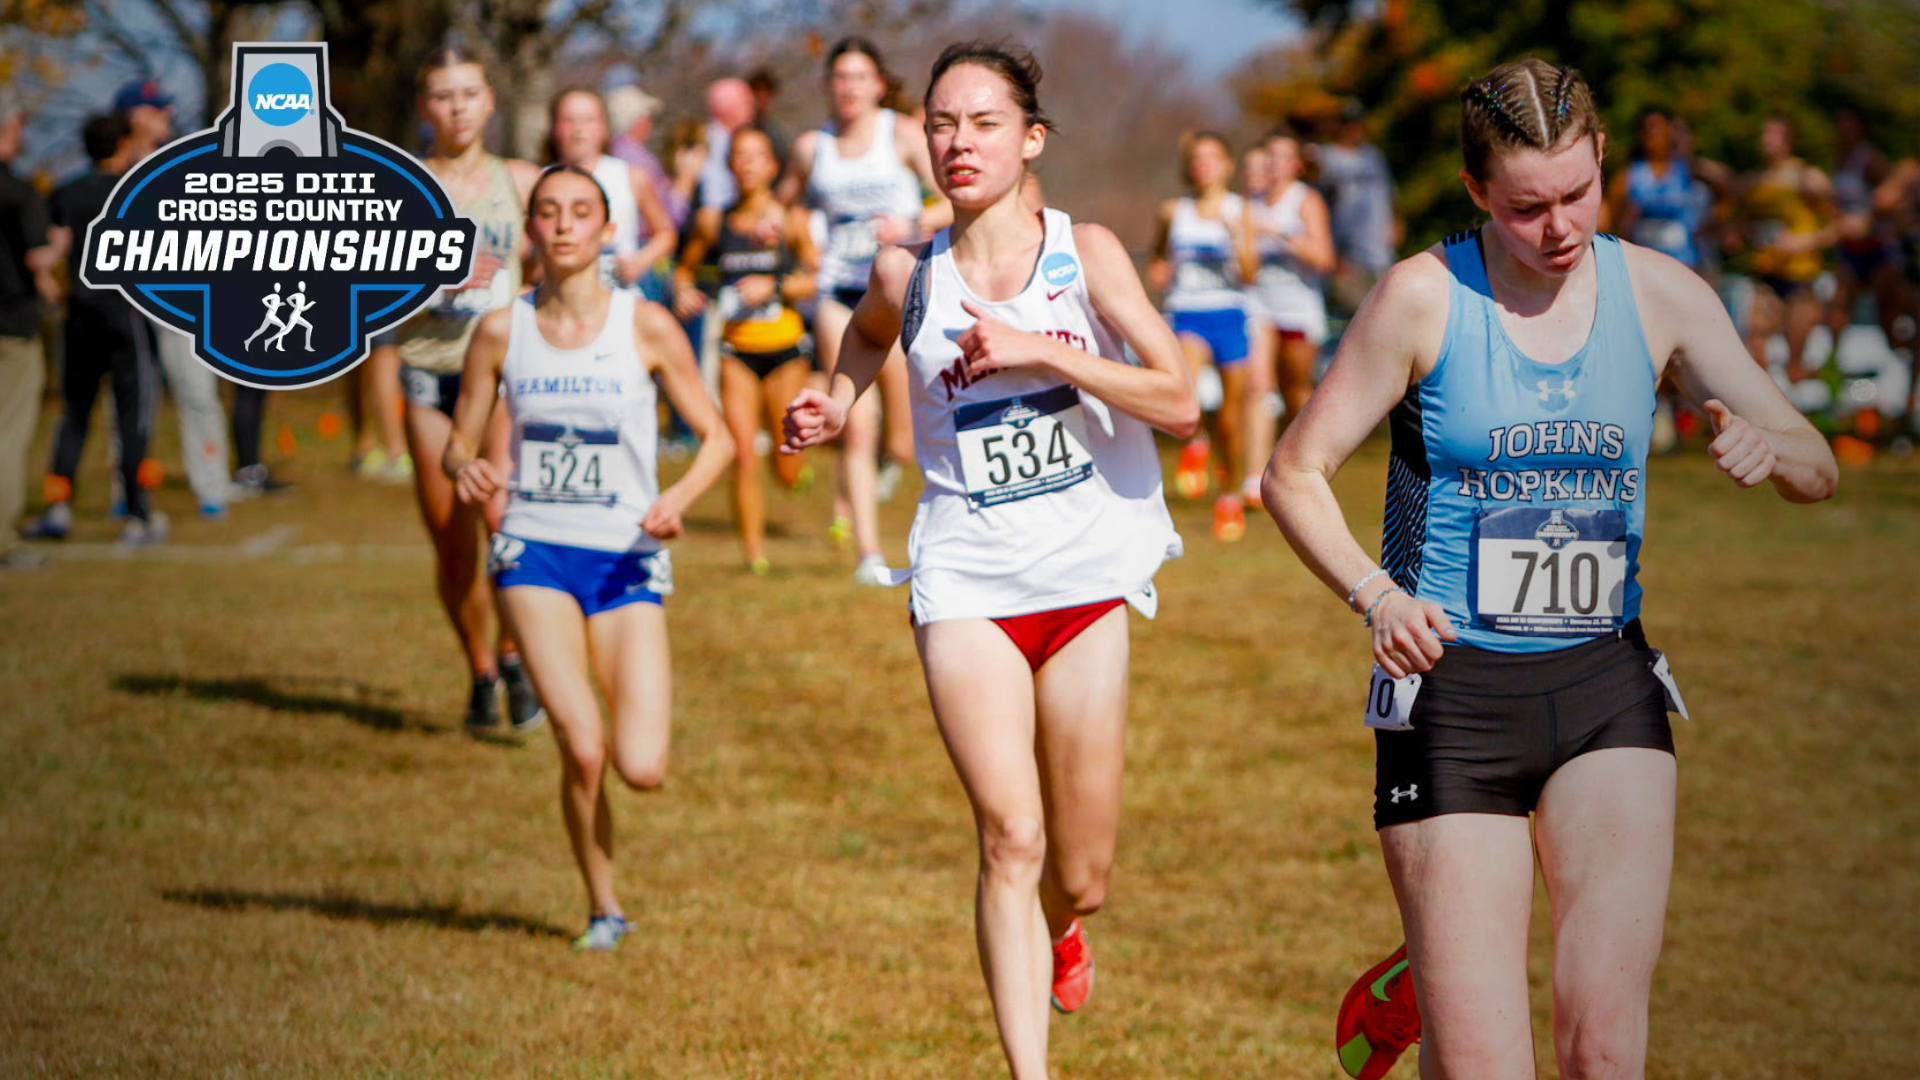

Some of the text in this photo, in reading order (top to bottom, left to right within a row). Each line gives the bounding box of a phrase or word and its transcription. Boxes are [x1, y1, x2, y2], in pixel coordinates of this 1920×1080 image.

[516, 376, 623, 396] HAMILTON
[982, 421, 1073, 486] 534
[1486, 420, 1625, 462] JOHNS
[539, 450, 603, 492] 524
[1458, 467, 1640, 503] HOPKINS
[1511, 551, 1600, 615] 710
